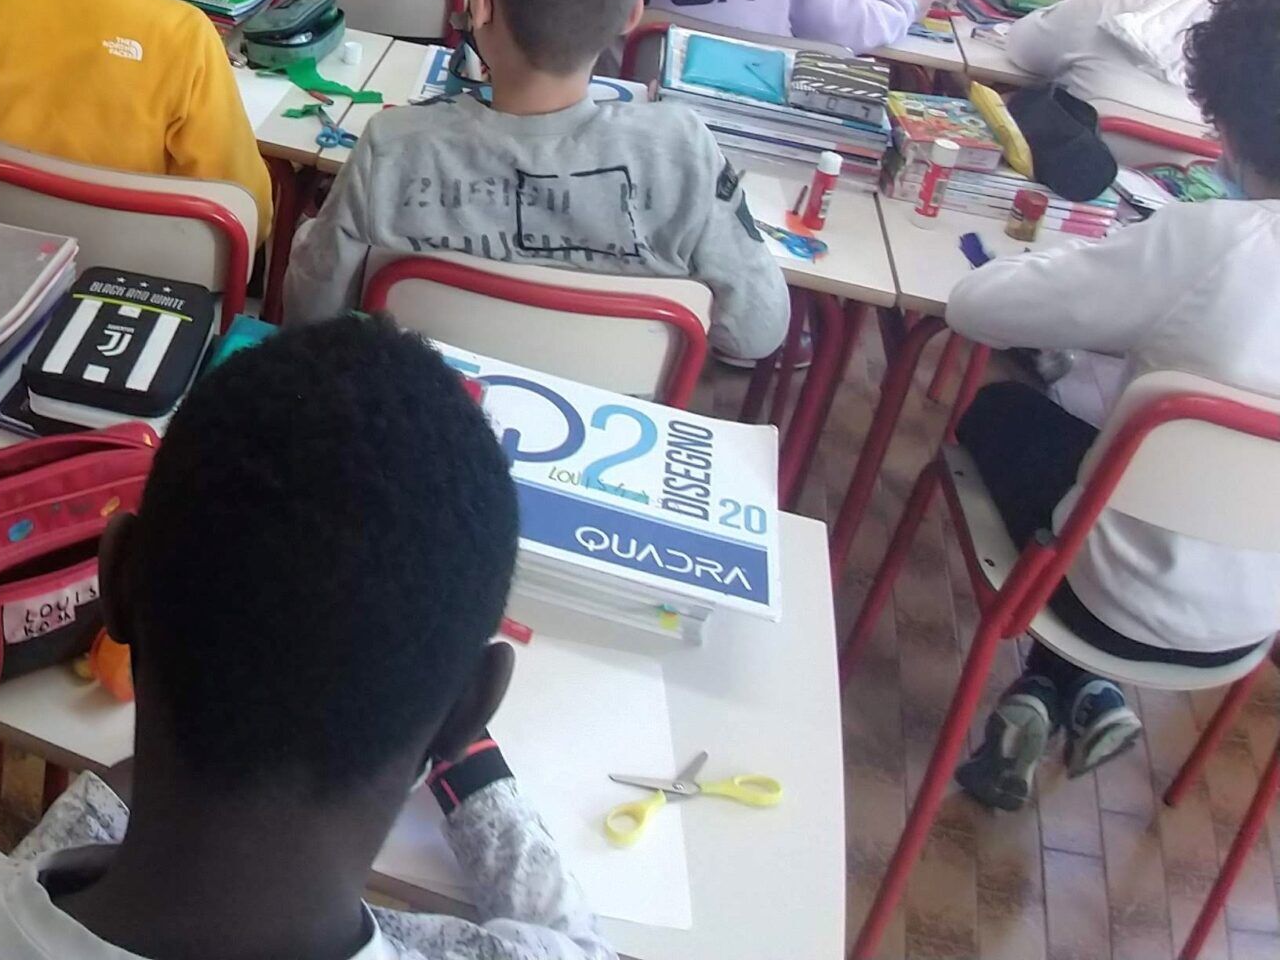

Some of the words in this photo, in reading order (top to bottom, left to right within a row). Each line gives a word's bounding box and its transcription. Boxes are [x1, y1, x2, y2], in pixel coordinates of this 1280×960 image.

[661, 419, 714, 522] DISEGNO
[718, 497, 768, 536] 20
[574, 525, 753, 592] QUADRA
[25, 585, 97, 624] LOUIS
